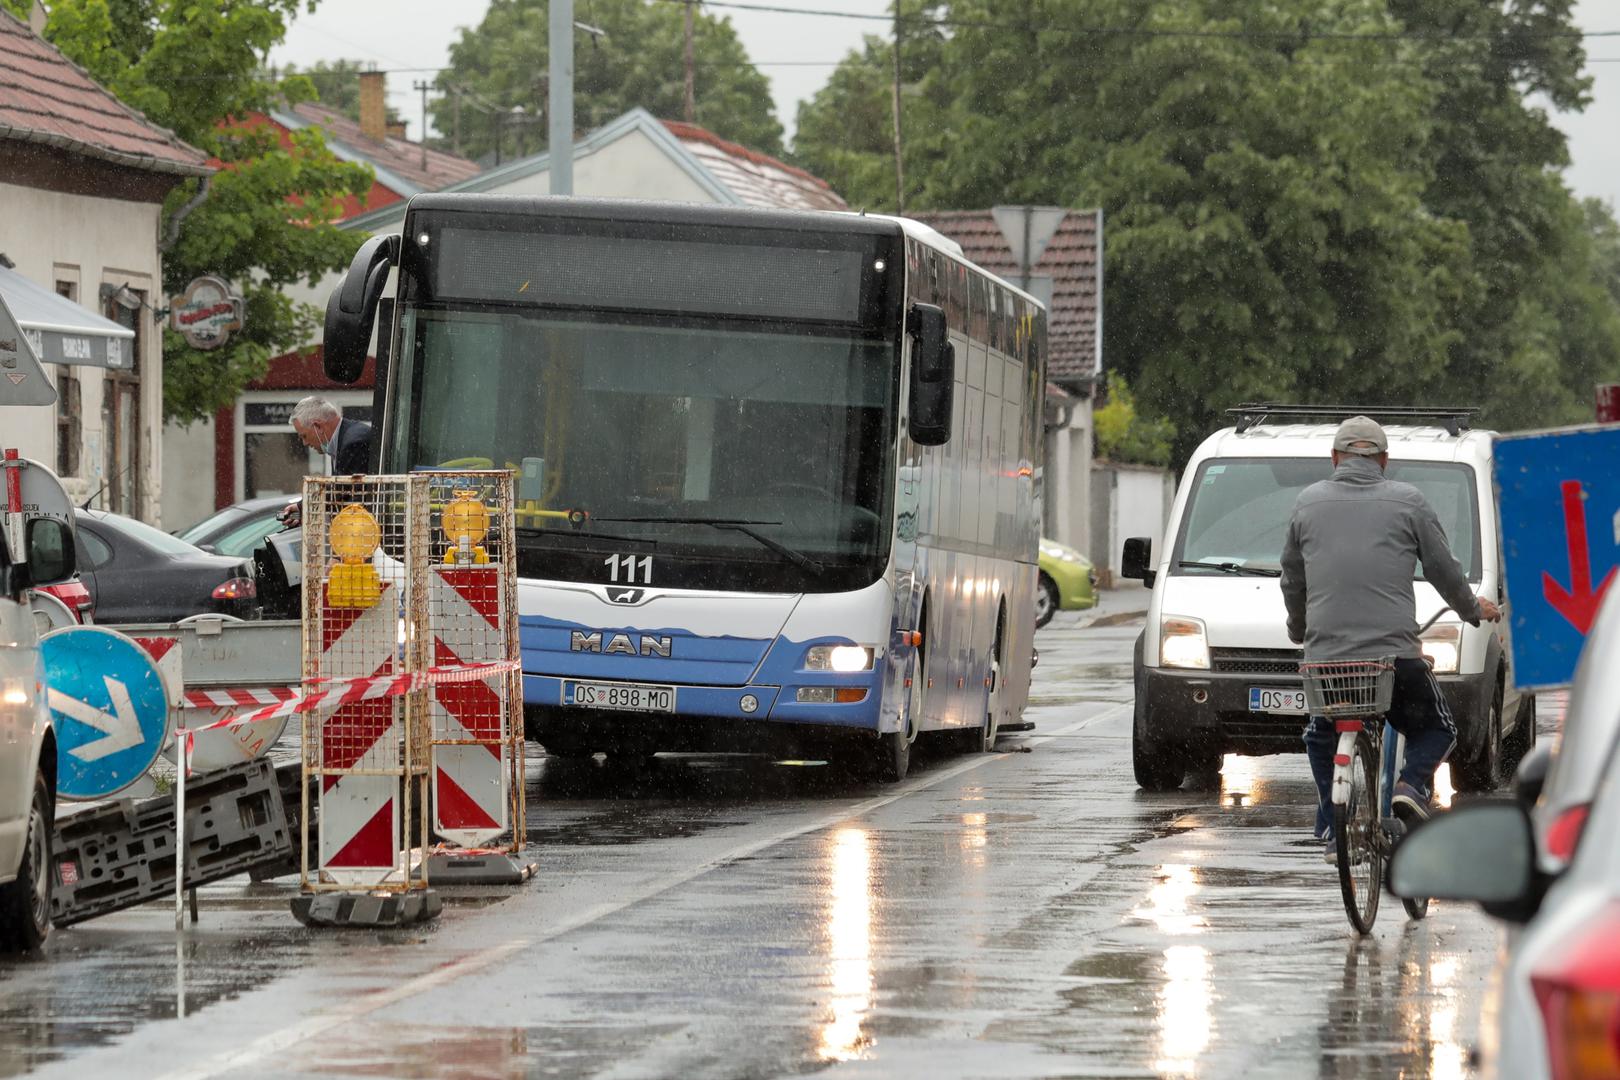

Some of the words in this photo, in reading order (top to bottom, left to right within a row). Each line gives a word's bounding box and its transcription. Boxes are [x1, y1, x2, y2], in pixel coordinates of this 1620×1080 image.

[604, 553, 653, 584] 111
[570, 630, 672, 658] MAN
[576, 686, 595, 703] OS
[609, 688, 669, 708] 898-MO
[1262, 691, 1282, 708] OS
[1295, 692, 1305, 709] 9
